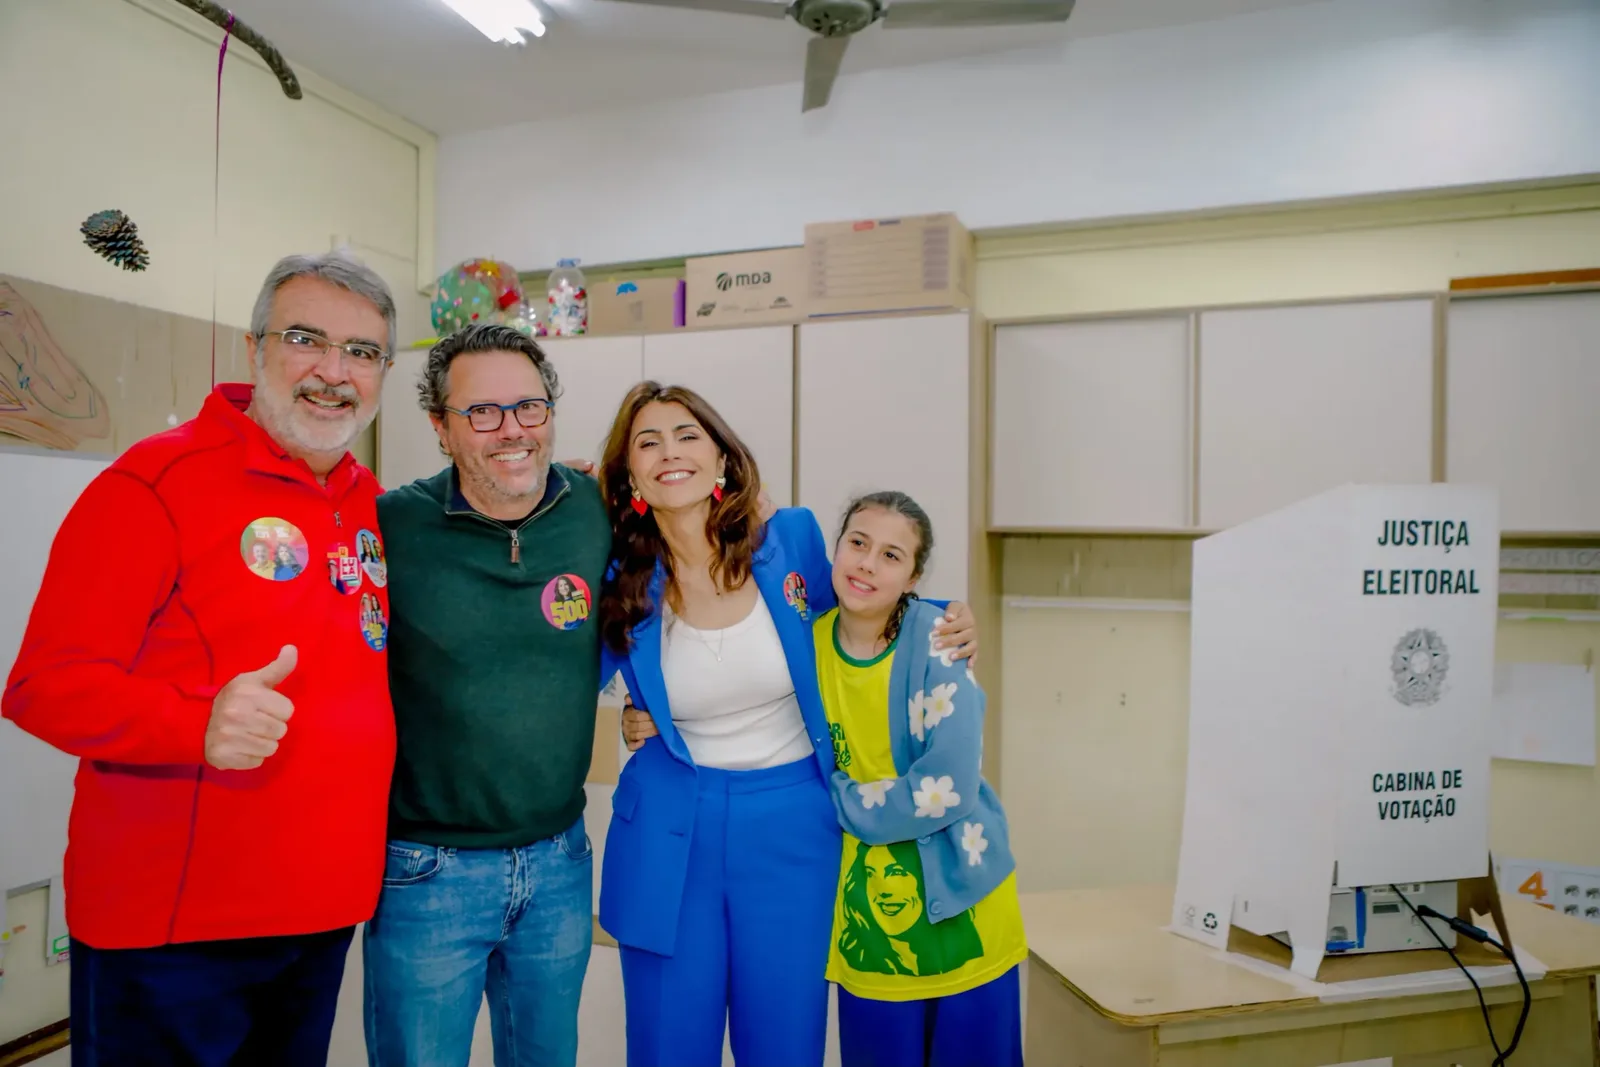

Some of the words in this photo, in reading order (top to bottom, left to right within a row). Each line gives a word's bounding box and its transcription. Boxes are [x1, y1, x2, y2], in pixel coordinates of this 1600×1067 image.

[1377, 519, 1469, 554] JUSTIÇA
[1362, 568, 1480, 595] ELEITORAL
[550, 598, 588, 626] 500
[1372, 770, 1436, 793] CABINA
[1442, 768, 1463, 789] DE
[1378, 793, 1456, 824] VOTAÇÃO
[1518, 871, 1548, 900] 4
